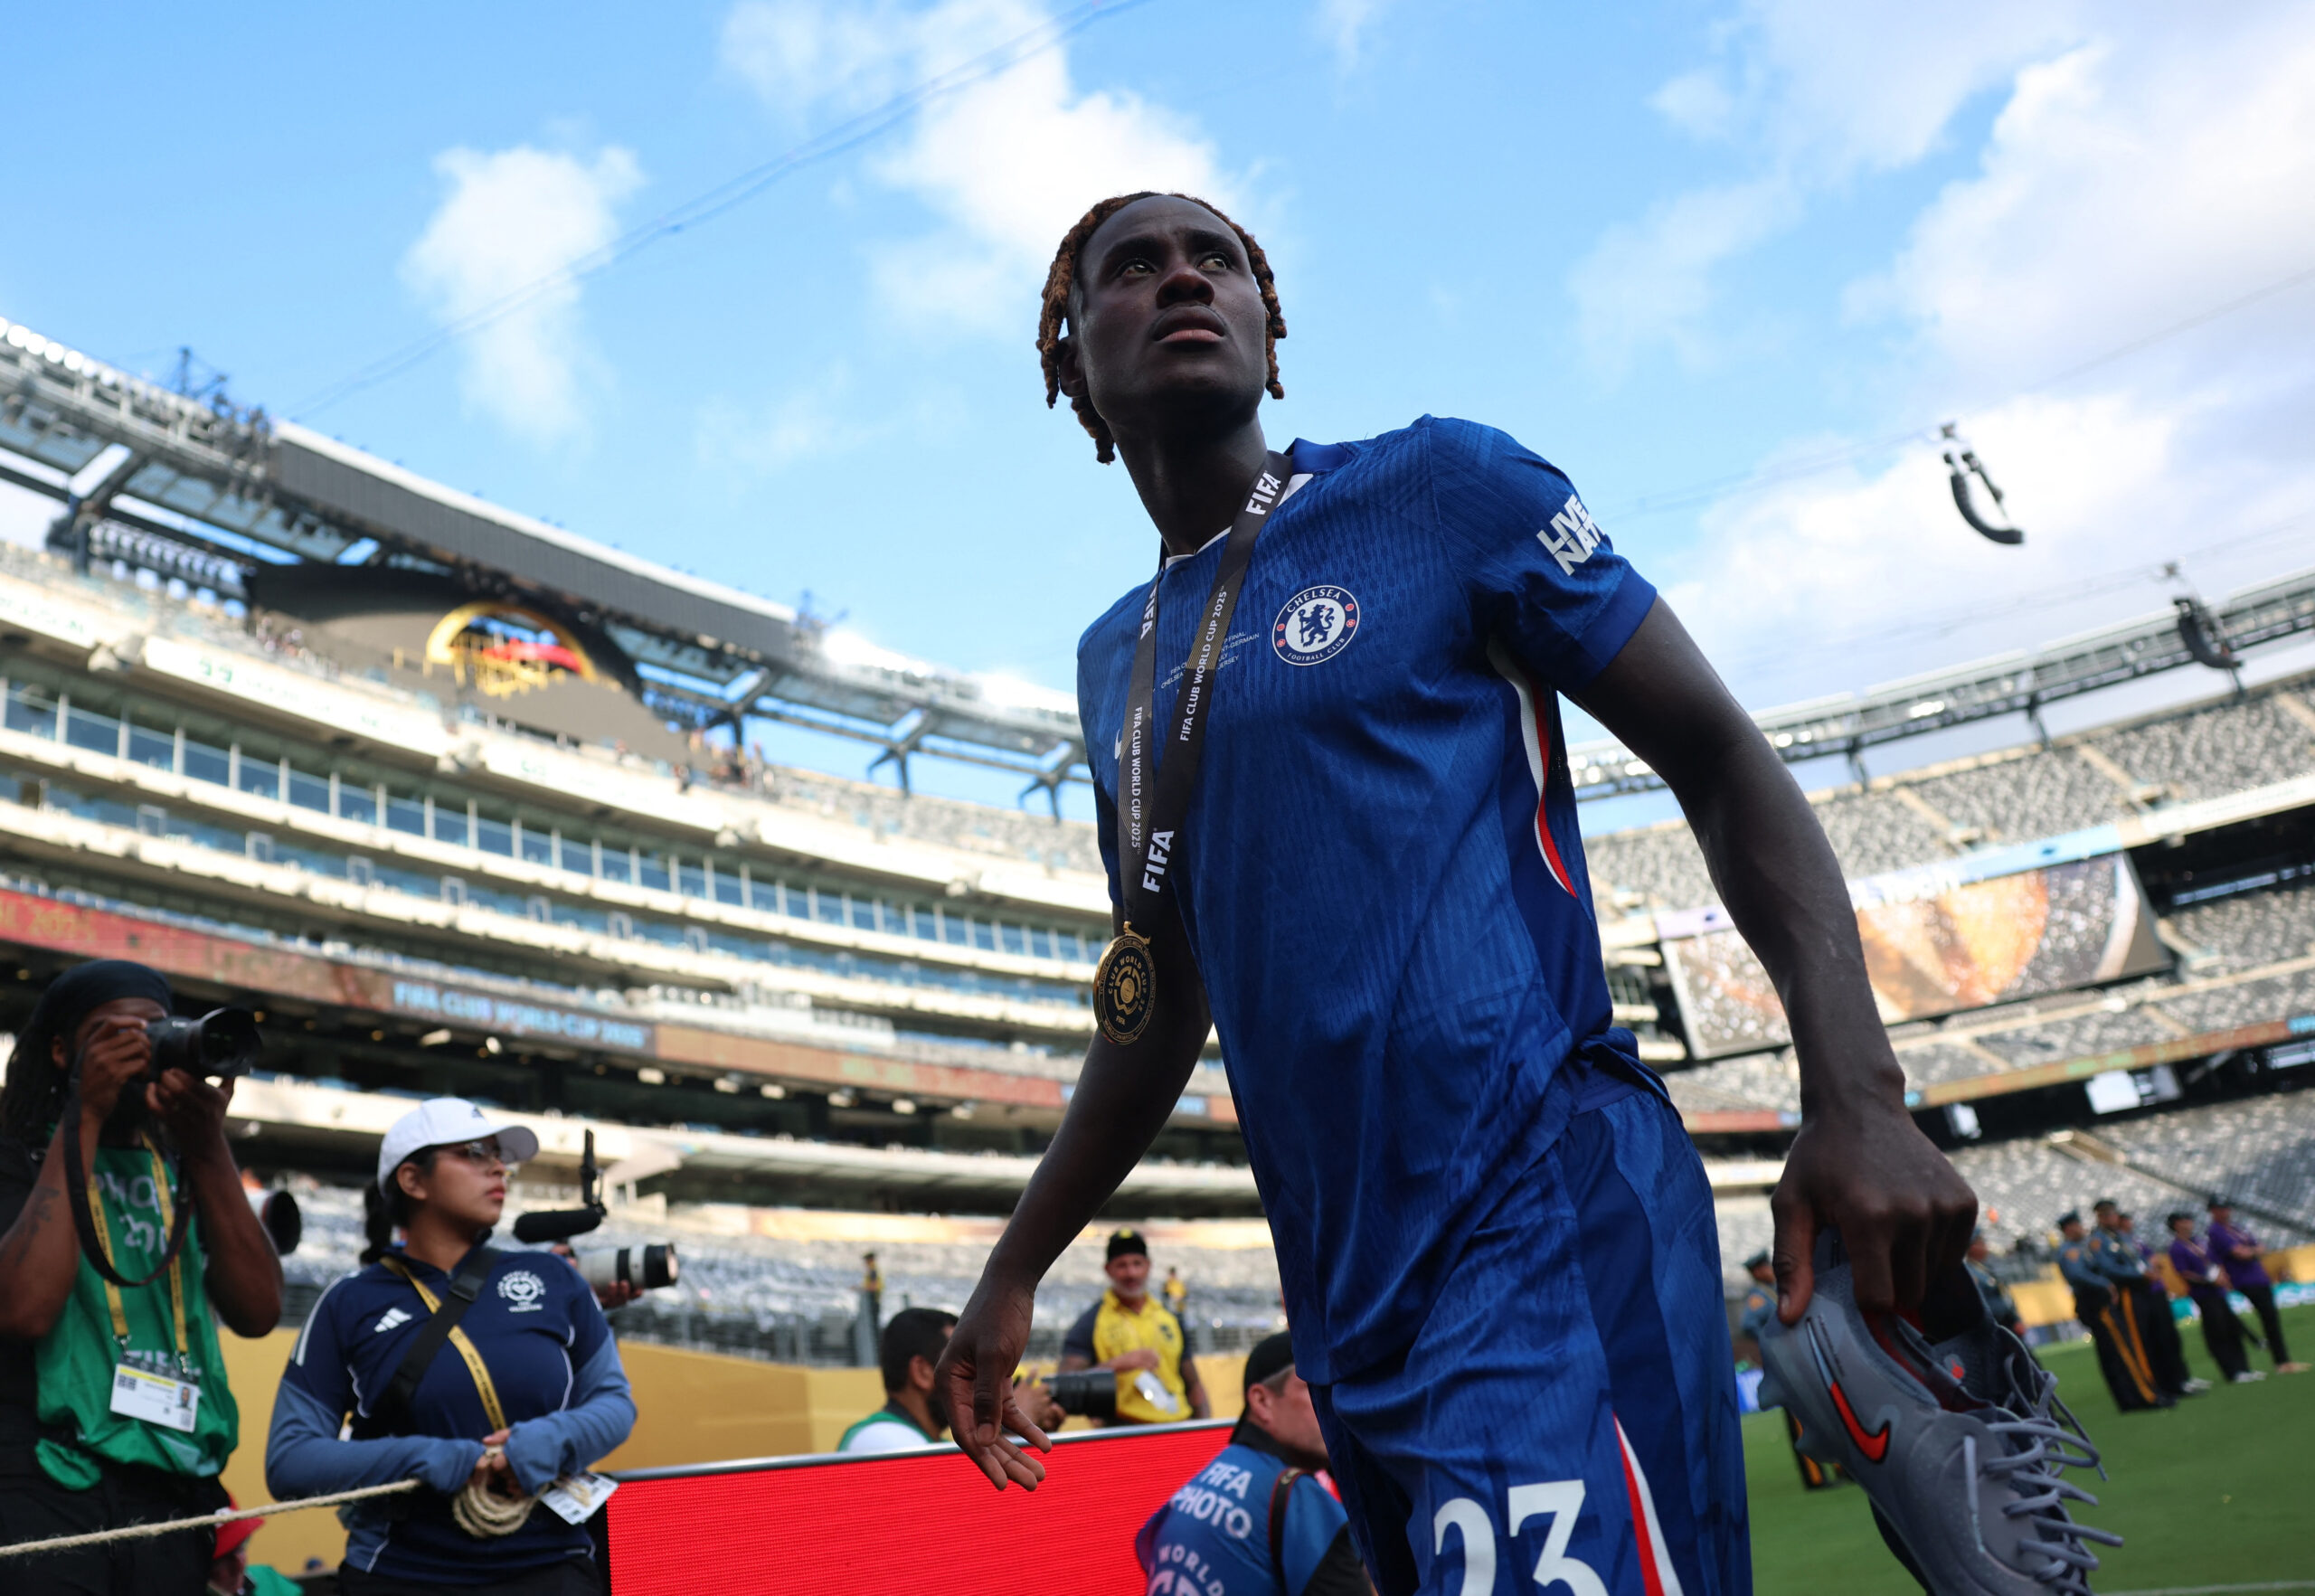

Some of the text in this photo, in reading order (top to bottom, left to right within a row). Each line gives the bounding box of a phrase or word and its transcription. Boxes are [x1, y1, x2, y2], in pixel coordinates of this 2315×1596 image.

[1245, 472, 1281, 515] FIFA
[1536, 494, 1588, 554] LIVE
[1554, 515, 1605, 576] NAT
[1140, 584, 1157, 640] FIFA
[1287, 589, 1340, 613] CHELSEA
[1205, 620, 1218, 642] CUP
[1228, 631, 1246, 642] FINAL
[1288, 637, 1345, 661] FOOTBALL CLUB
[1160, 671, 1184, 689] CHELSEA
[1194, 644, 1211, 684] WORLD
[1132, 706, 1143, 729] FIFA
[1186, 686, 1201, 714] CLUB
[1131, 730, 1141, 756] CLUB
[1180, 717, 1194, 741] FIFA
[1131, 758, 1141, 797] WORLD
[1131, 798, 1141, 820] CUP
[1142, 831, 1175, 892] FIFA
[1108, 966, 1119, 995] CLUB
[1120, 955, 1142, 969] WORLD
[392, 981, 439, 1011] FIFA
[441, 990, 493, 1020] CLUB
[495, 1000, 562, 1034] WORLD
[562, 1012, 600, 1040] CUP
[1200, 1461, 1252, 1499] FIFA
[1171, 1486, 1252, 1539] PHOTO
[1433, 1478, 1609, 1596] 23
[1158, 1543, 1224, 1596] WORLD
